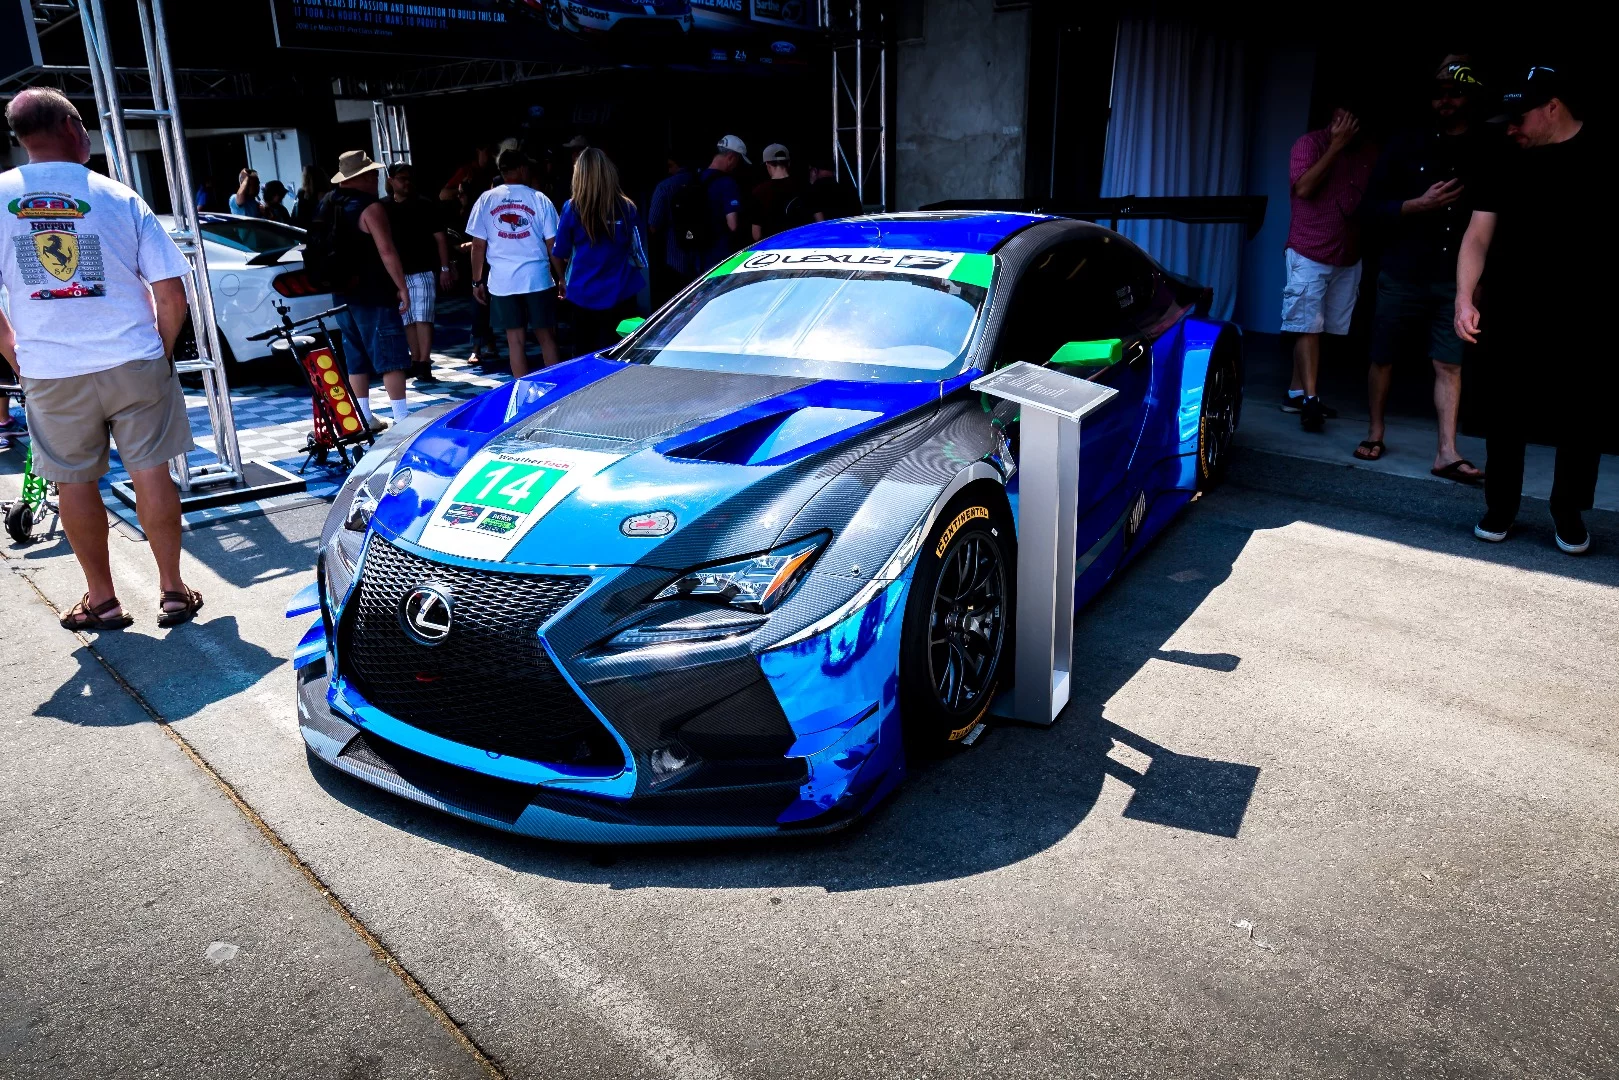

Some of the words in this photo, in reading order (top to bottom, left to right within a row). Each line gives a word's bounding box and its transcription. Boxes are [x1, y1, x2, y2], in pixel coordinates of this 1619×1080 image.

[325, 0, 346, 8] YEARS
[348, 0, 357, 9] OF
[359, 0, 388, 12] PASSION
[390, 2, 404, 14] AND
[406, 4, 446, 18] INNOVATION
[448, 8, 456, 19] TO
[457, 9, 476, 21] BUILD
[477, 11, 492, 22] THIS
[493, 12, 507, 23] CAR.
[567, 2, 610, 22] EcoBoost
[715, 0, 743, 12] MANS
[293, 6, 301, 17] IT
[304, 7, 324, 19] TOOK
[337, 9, 361, 22] HOURS
[364, 12, 372, 23] AT
[374, 13, 382, 24] LE
[384, 14, 404, 26] MANS
[406, 16, 414, 27] TO
[416, 17, 437, 29] PROVE
[32, 199, 65, 209] 28
[30, 221, 76, 231] Ferrari
[782, 254, 893, 265] LEXUS
[498, 454, 570, 469] WeatherTech
[476, 465, 547, 506] 14
[936, 507, 988, 557] CONTINENTAL
